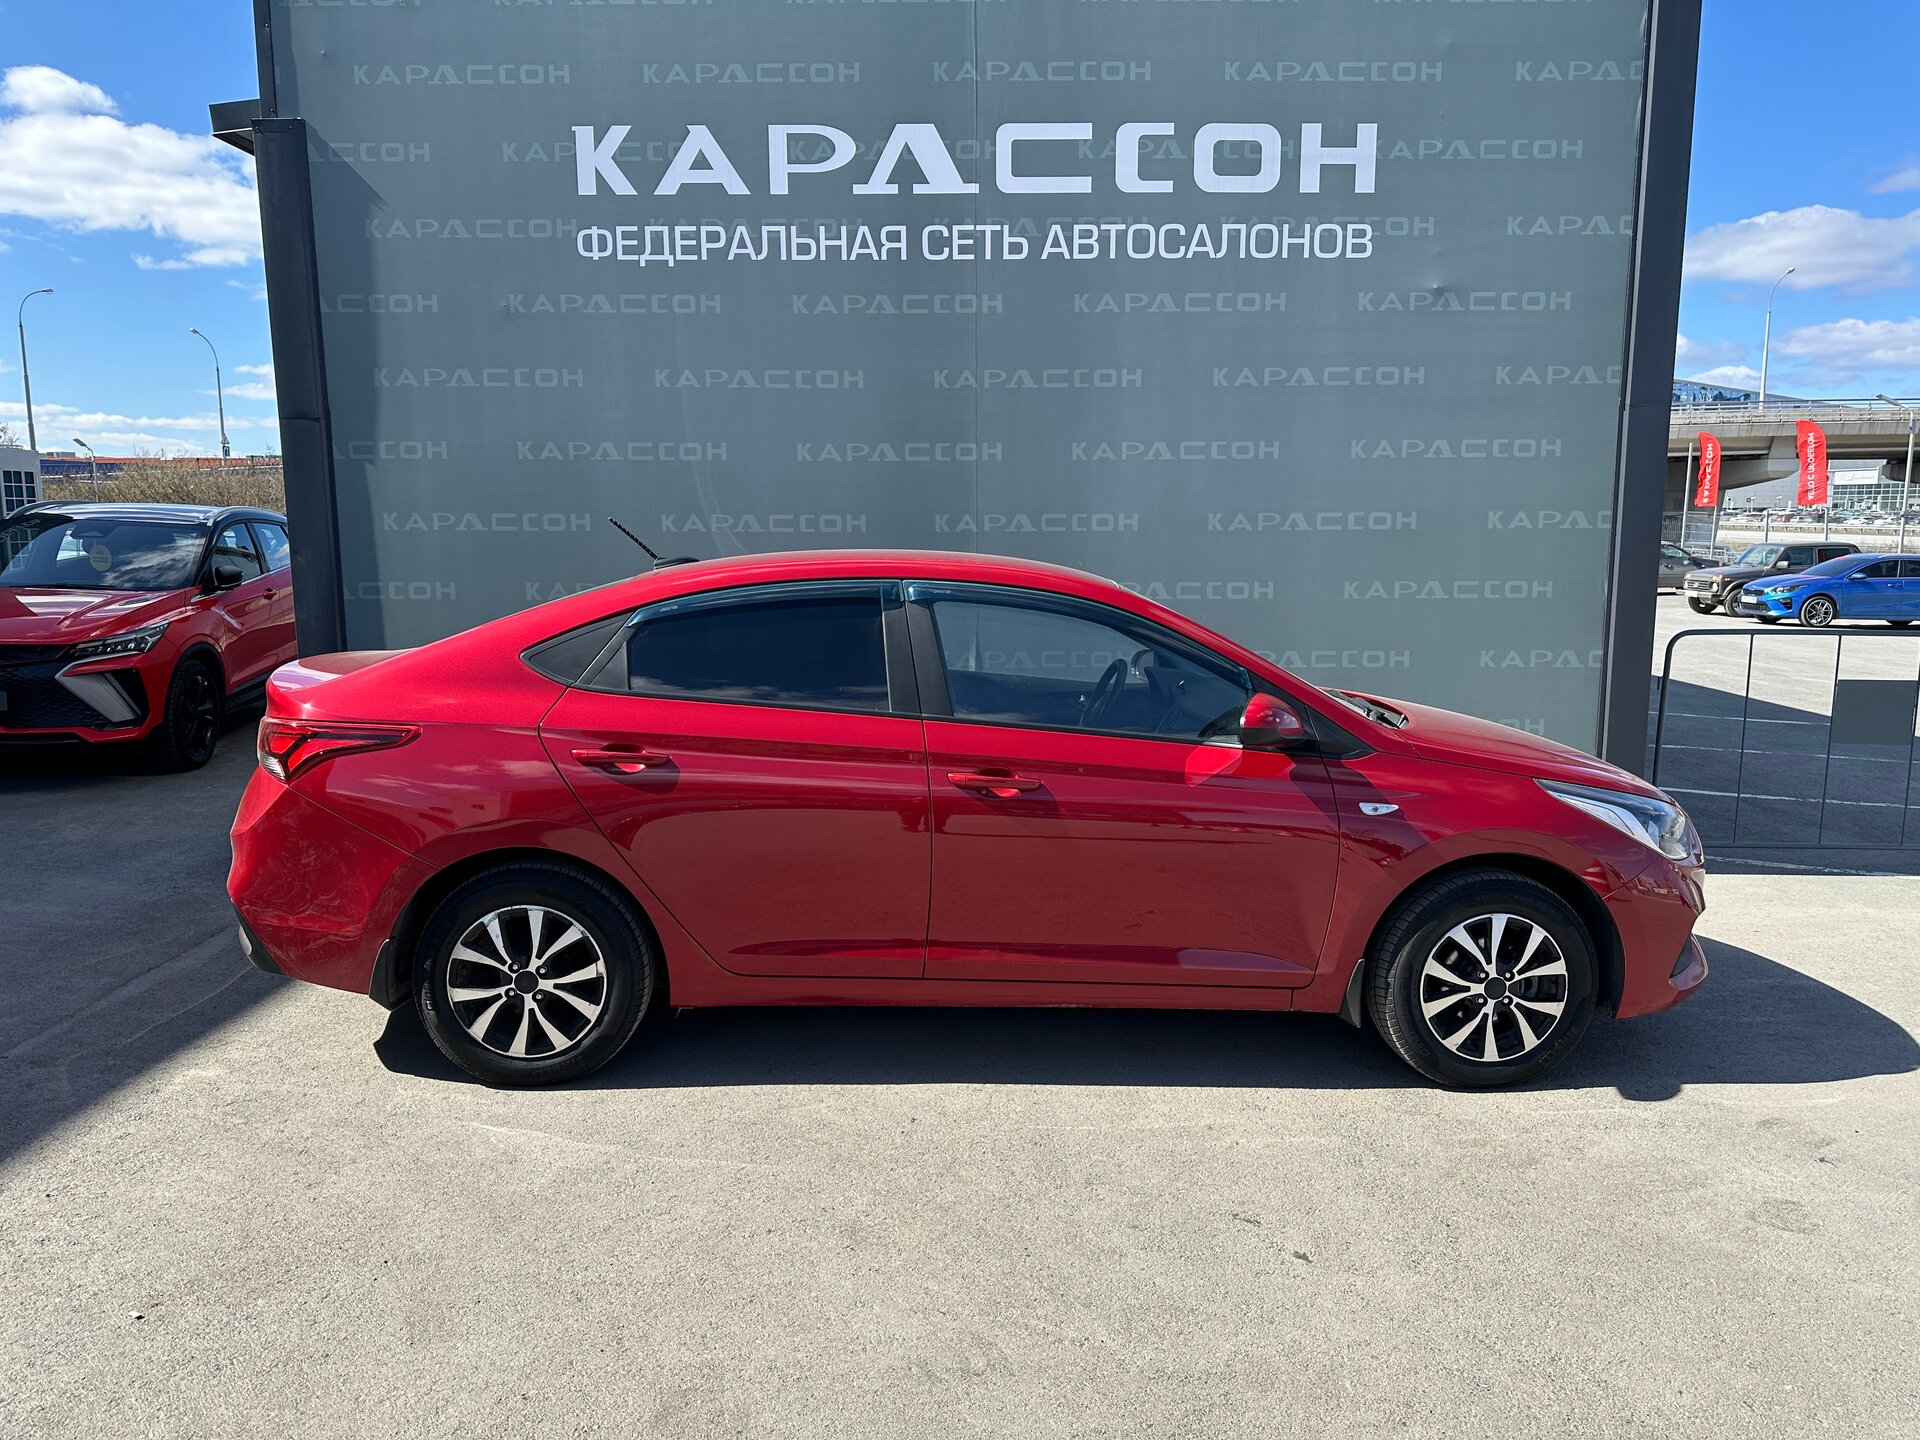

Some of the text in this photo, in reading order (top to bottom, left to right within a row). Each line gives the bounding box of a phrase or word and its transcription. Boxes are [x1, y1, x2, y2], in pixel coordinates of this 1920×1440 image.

[571, 121, 1379, 196] КАРАССОН
[576, 222, 1374, 268] ФЕДЕРАЛЬНАЯ СЕТЬ АВТОСАЛОНОВ
